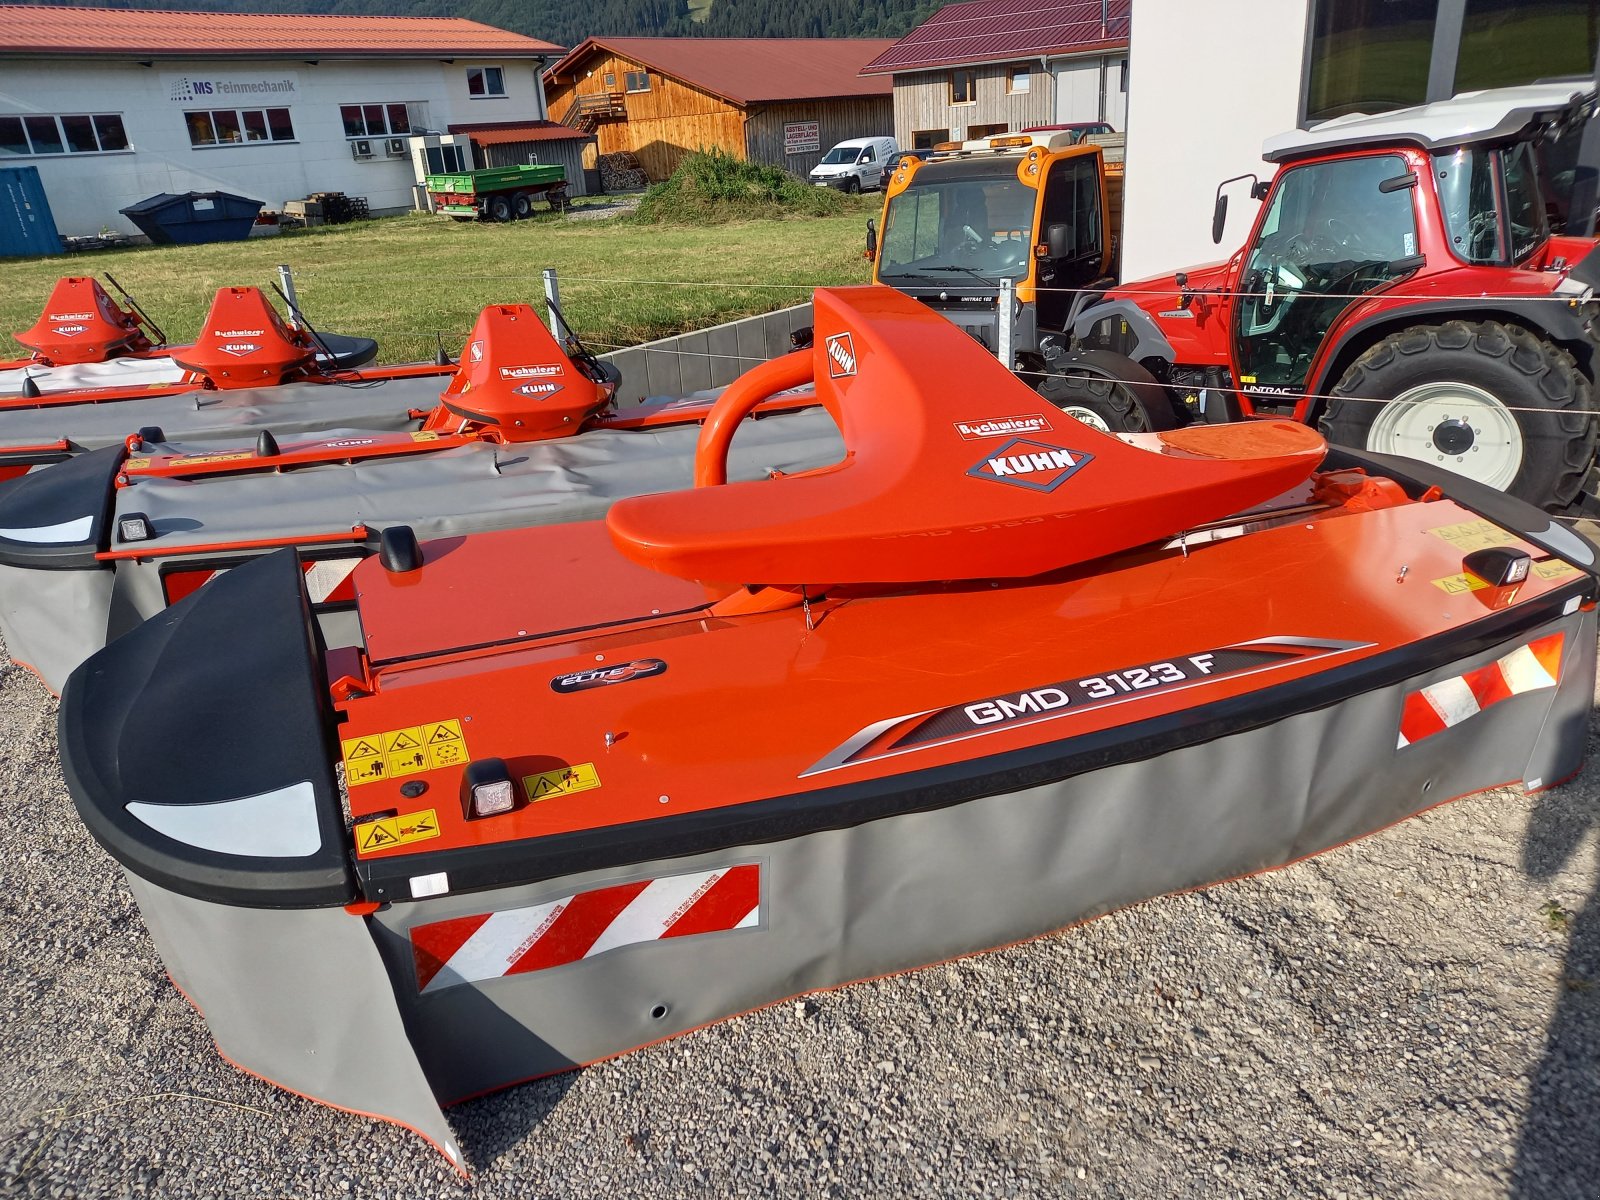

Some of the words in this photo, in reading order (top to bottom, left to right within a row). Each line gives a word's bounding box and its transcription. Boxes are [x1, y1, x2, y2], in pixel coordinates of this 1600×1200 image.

[193, 82, 213, 94] MS
[216, 80, 295, 94] Feinmechanik
[215, 330, 264, 338] Buchwieser
[829, 338, 854, 374] KUHN
[501, 365, 560, 377] Buchwieser
[521, 383, 555, 394] KUHN
[1243, 385, 1291, 395] LINTRAC
[958, 417, 1046, 437] Buchwieser
[987, 449, 1077, 477] KUHN
[561, 666, 626, 686] ELITE
[963, 688, 1070, 726] GMD
[1078, 662, 1187, 700] 3123
[1188, 653, 1215, 675] F
